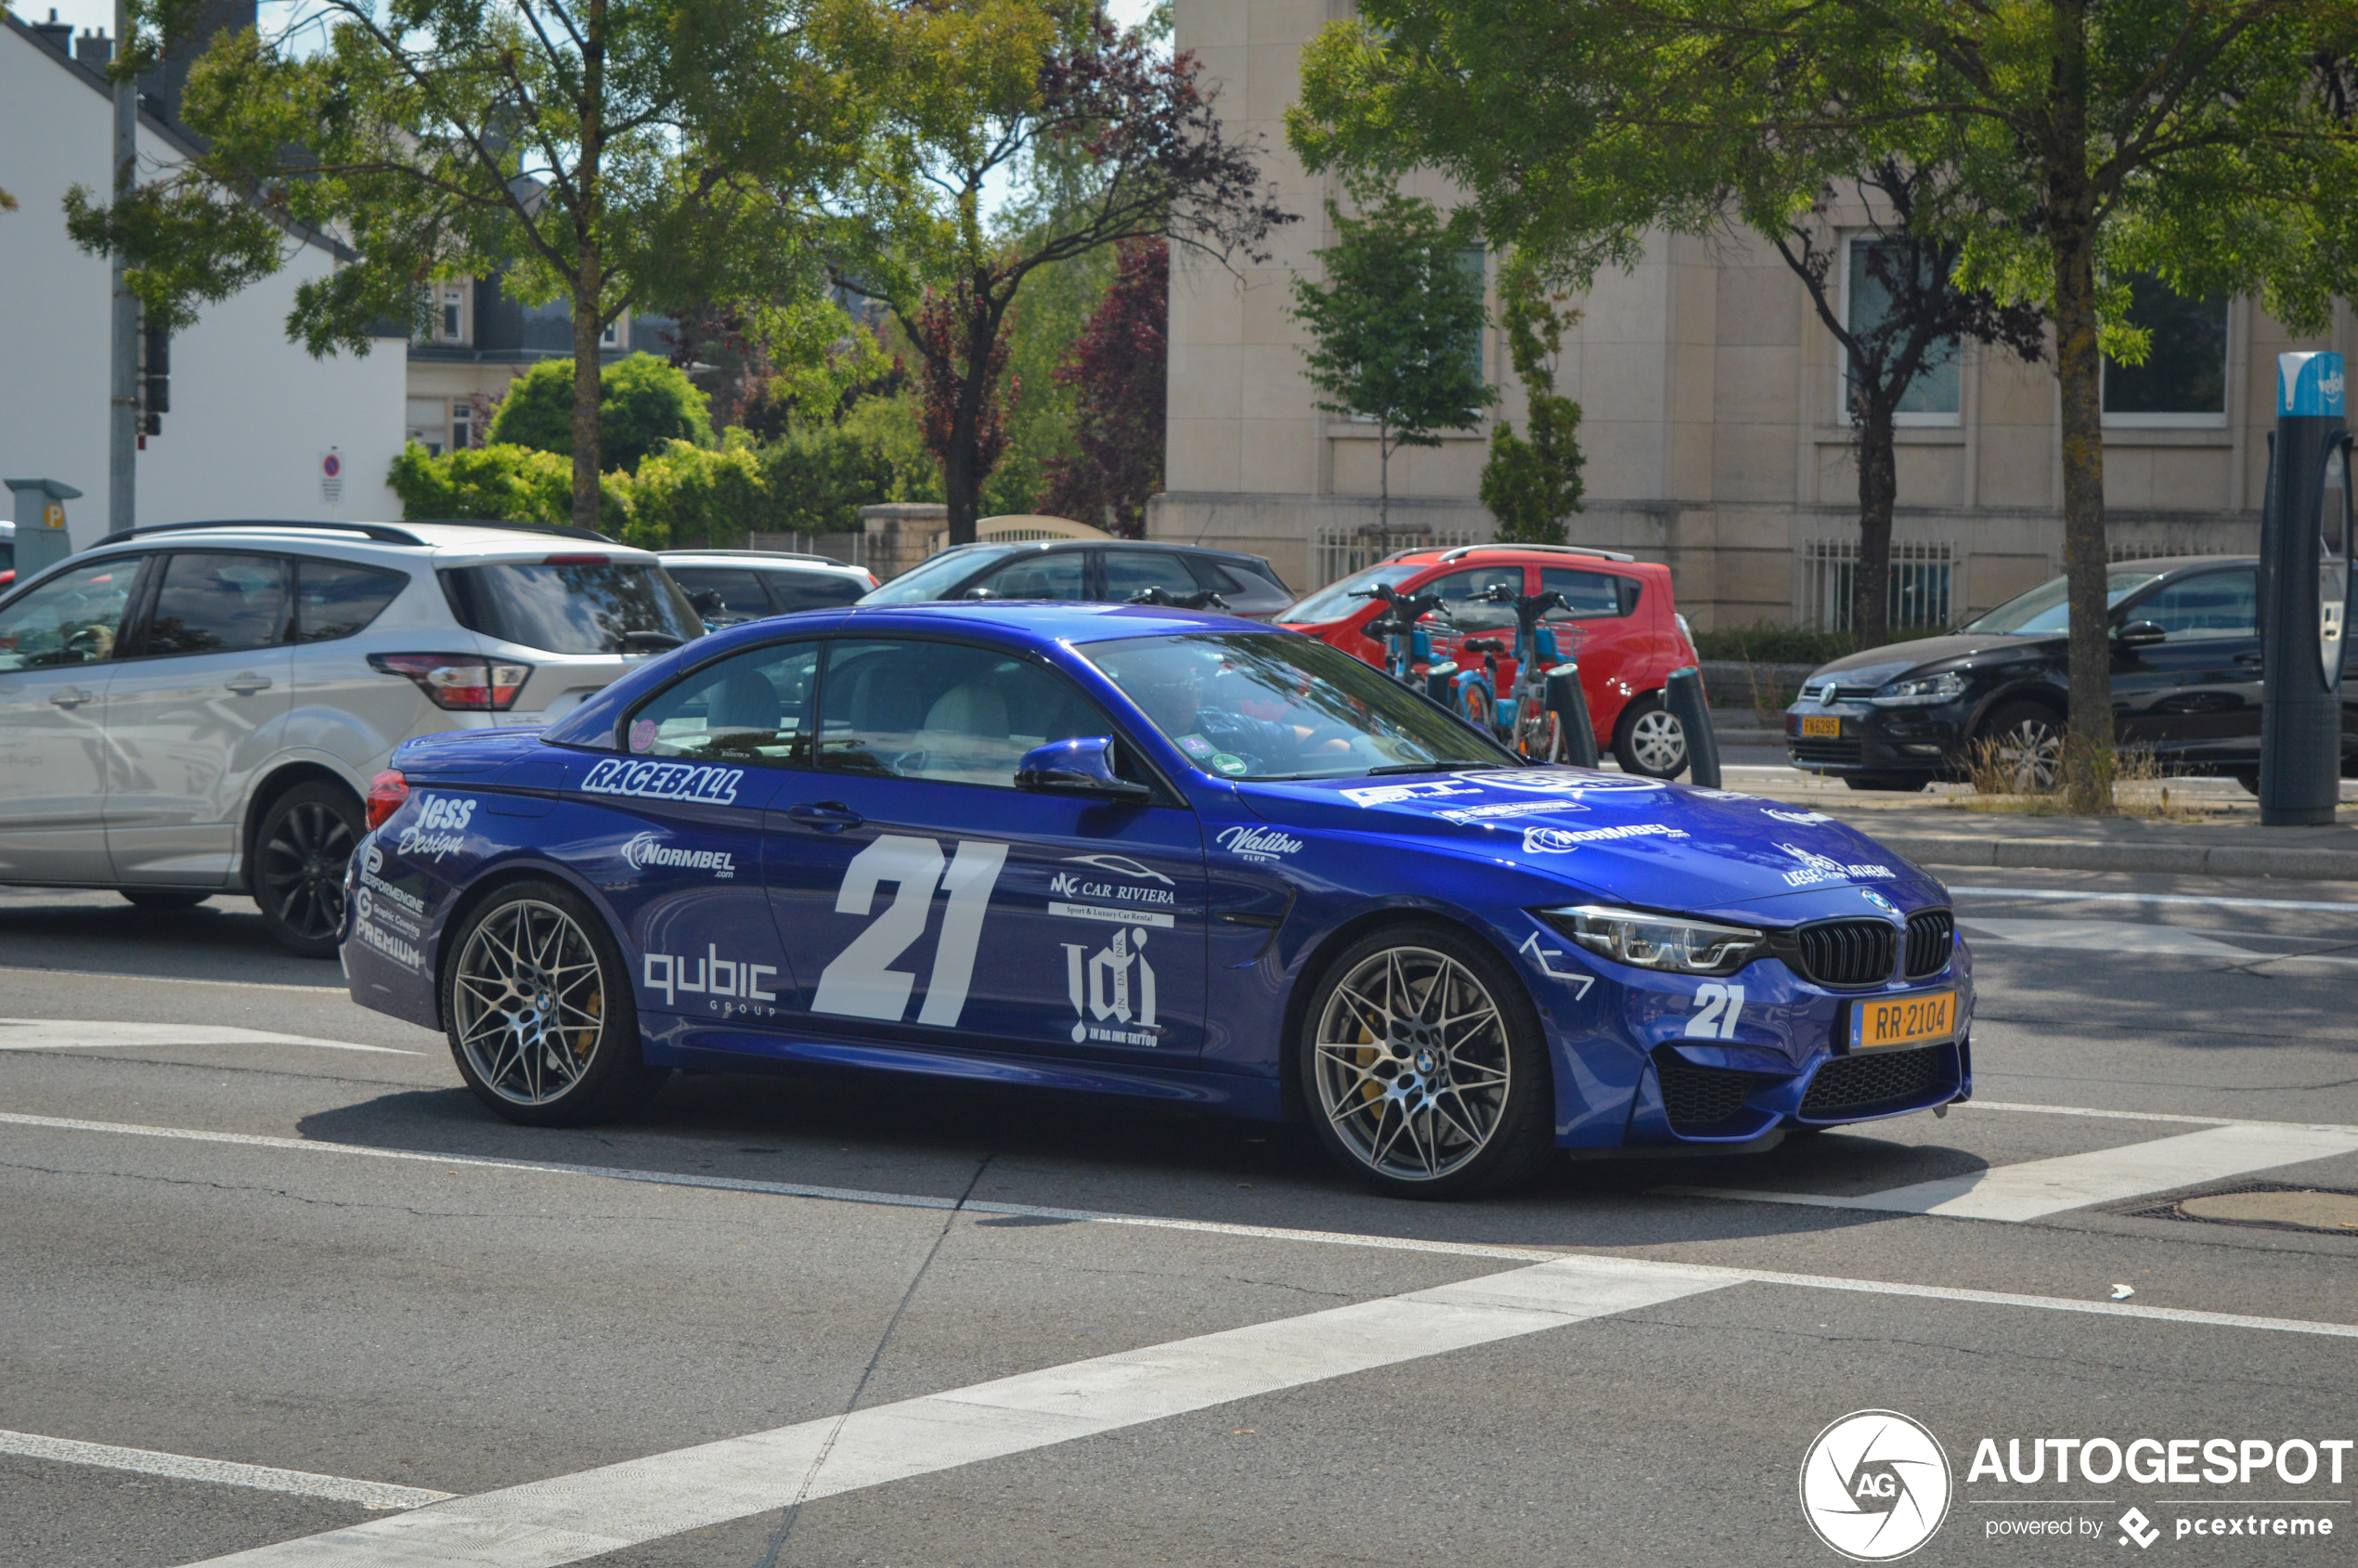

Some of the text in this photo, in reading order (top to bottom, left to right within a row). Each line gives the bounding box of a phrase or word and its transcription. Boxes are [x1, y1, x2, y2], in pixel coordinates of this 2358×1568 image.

[581, 758, 744, 806] RACEBALL
[414, 794, 477, 829] Jess
[397, 826, 464, 863] Design
[714, 870, 734, 878] .com
[1781, 868, 1823, 888] LIEGE
[1846, 864, 1896, 878] ATHENS
[1082, 882, 1112, 898] CAR
[1116, 886, 1175, 904] RIVIERA
[810, 834, 1010, 1028] 21
[1067, 905, 1085, 914] Sport
[1094, 909, 1117, 920] Luxury
[1118, 911, 1130, 920] Car
[1132, 912, 1153, 922] Rental
[356, 915, 420, 968] PREMIUM
[643, 942, 777, 1005] qubic
[1115, 938, 1125, 1009] IN DA INK
[709, 1000, 776, 1017] GROUP
[1684, 983, 1744, 1038] 21
[1876, 999, 1946, 1040] RR 2104
[1089, 1028, 1158, 1047] IN DA INK TATTOO
